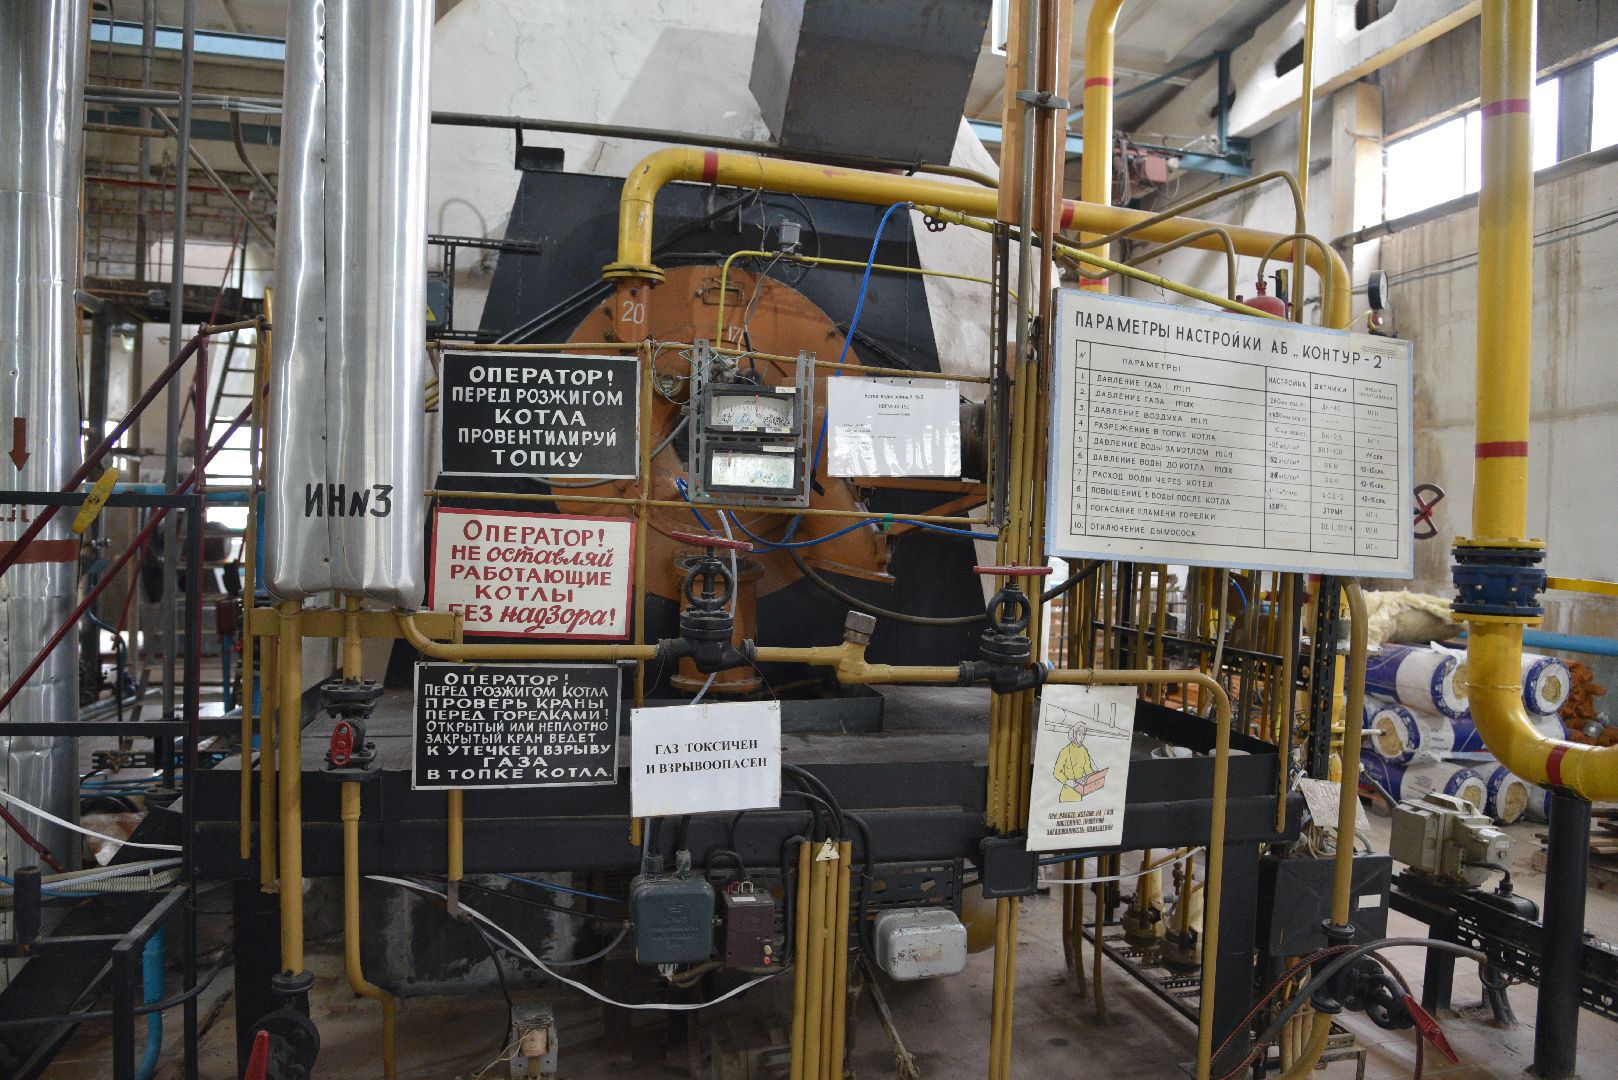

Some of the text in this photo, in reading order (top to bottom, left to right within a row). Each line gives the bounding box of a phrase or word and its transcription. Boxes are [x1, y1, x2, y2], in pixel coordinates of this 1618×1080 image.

[622, 301, 645, 324] 20
[1075, 310, 1170, 338] ПАРАМЕТРЫ
[1176, 325, 1261, 352] НАСТРОЙКИ
[1271, 338, 1288, 354] АБ
[1122, 358, 1181, 372] ПАРАМЕТРЫ
[469, 366, 614, 386] ОПЕРАТОР!
[1096, 374, 1191, 393] ДАВЛЕНИЕ ГАЗА min
[452, 386, 622, 406] ПЕРЕД РОЗЖИГОМ
[1314, 383, 1347, 393] ДАТЧИКИ
[1095, 390, 1195, 408] ДАВЛЕНИЕ ГАЗА max
[495, 408, 586, 427] КОТЛА
[1094, 406, 1208, 425] ДАВЛЕНИЕ ВОЗДУХА min
[458, 427, 616, 447] ПРОВЕНТИЛИРУЙ
[1094, 420, 1150, 434] РАЗРЕЖЕНИЕ
[1162, 428, 1186, 438] ТОПКЕ
[1191, 432, 1216, 441] КОТЛА
[1094, 437, 1138, 449] ДАВЛЕНИЕ
[1140, 442, 1162, 451] ВОДЫ
[1166, 444, 1175, 452] ЗА
[1176, 446, 1209, 456] КОТЛОМ
[492, 450, 582, 468] ТОПКУ
[1093, 453, 1233, 474] ДАВЛЕНИЕ ВОДЫ ДО КОТЛА max
[1092, 471, 1213, 488] РАСХОД ВОДЫ ЧЕРЕЗ КОТЕЛ
[1091, 486, 1142, 498] ПОВЫШЕНИЕ
[1151, 492, 1174, 501] ВОДЫ
[1176, 494, 1201, 503] ПОСЛЕ
[1205, 497, 1231, 506] КОТЛА
[1090, 504, 1216, 520] ПОГАСАНИЕ ПЛАМЕНИ ГОРЕЛКИ
[464, 519, 605, 547] ОПЕРАТОР!
[1090, 522, 1196, 538] ОТКЛЮЧЕНИЕ ДЫМОСОСА
[451, 545, 613, 568] НЕ оставляй
[451, 564, 612, 588] РАБОТАЮЩИЕ
[476, 584, 573, 603] КОТЛЫ
[500, 604, 616, 633] надзора!
[444, 672, 569, 686] ОПЕРАТОР!
[424, 684, 608, 697] ПЕРЕД РОЗЖИГОМ КОТЛА
[425, 698, 604, 709] ПРОВЕРЬ КРАНЫ
[426, 710, 485, 721] ПЕРЕД
[426, 720, 608, 732] ОТКРЫТЫЙ ИЛИ НЕПЛОТНО
[425, 732, 596, 744] ЗАКРЫТЫЙ КРАН ВЕДЕТ
[656, 740, 757, 754] ГАЗ ТОКСИЧЕН
[428, 744, 611, 756] К УТЕЧКЕ И ВЗРЫВУ
[483, 756, 548, 768] ГАЗА
[646, 758, 766, 774] И ВЗРЫВООПАСЕН
[428, 768, 612, 780] В ТОПКЕ КОТЛА.
